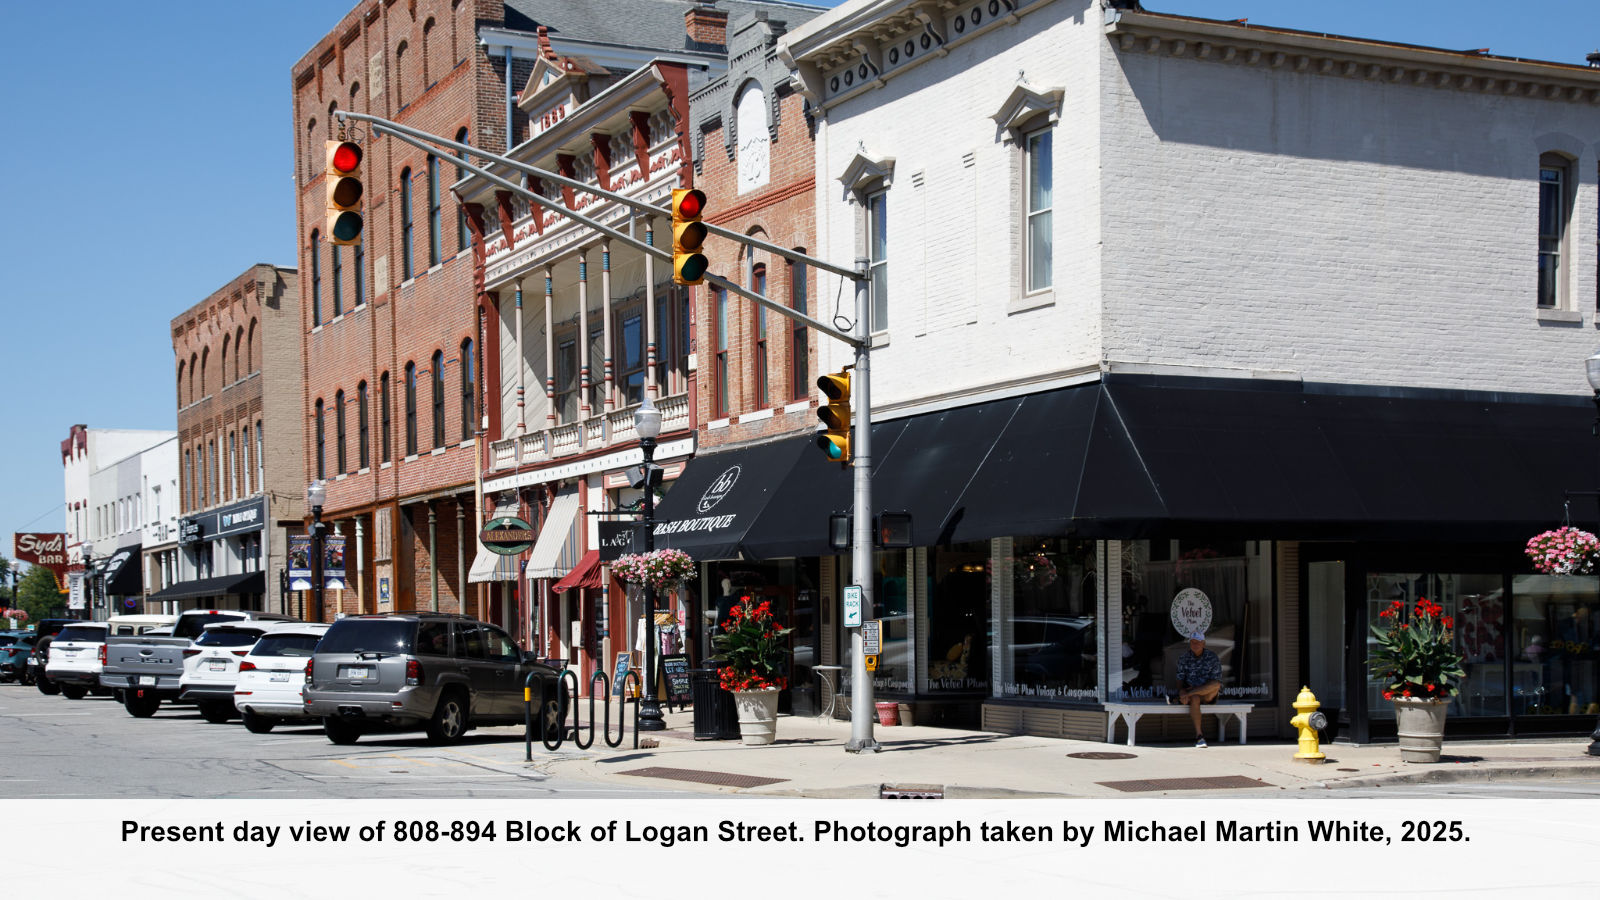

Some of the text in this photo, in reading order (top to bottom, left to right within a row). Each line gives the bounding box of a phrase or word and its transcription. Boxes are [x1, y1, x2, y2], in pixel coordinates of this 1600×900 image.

[653, 513, 737, 536] BASH BOUTIQUE
[38, 554, 64, 564] BAR
[1181, 606, 1203, 618] Velvet
[941, 677, 964, 689] Velvet
[1004, 682, 1020, 694] Velvet
[1130, 685, 1153, 698] Velvet
